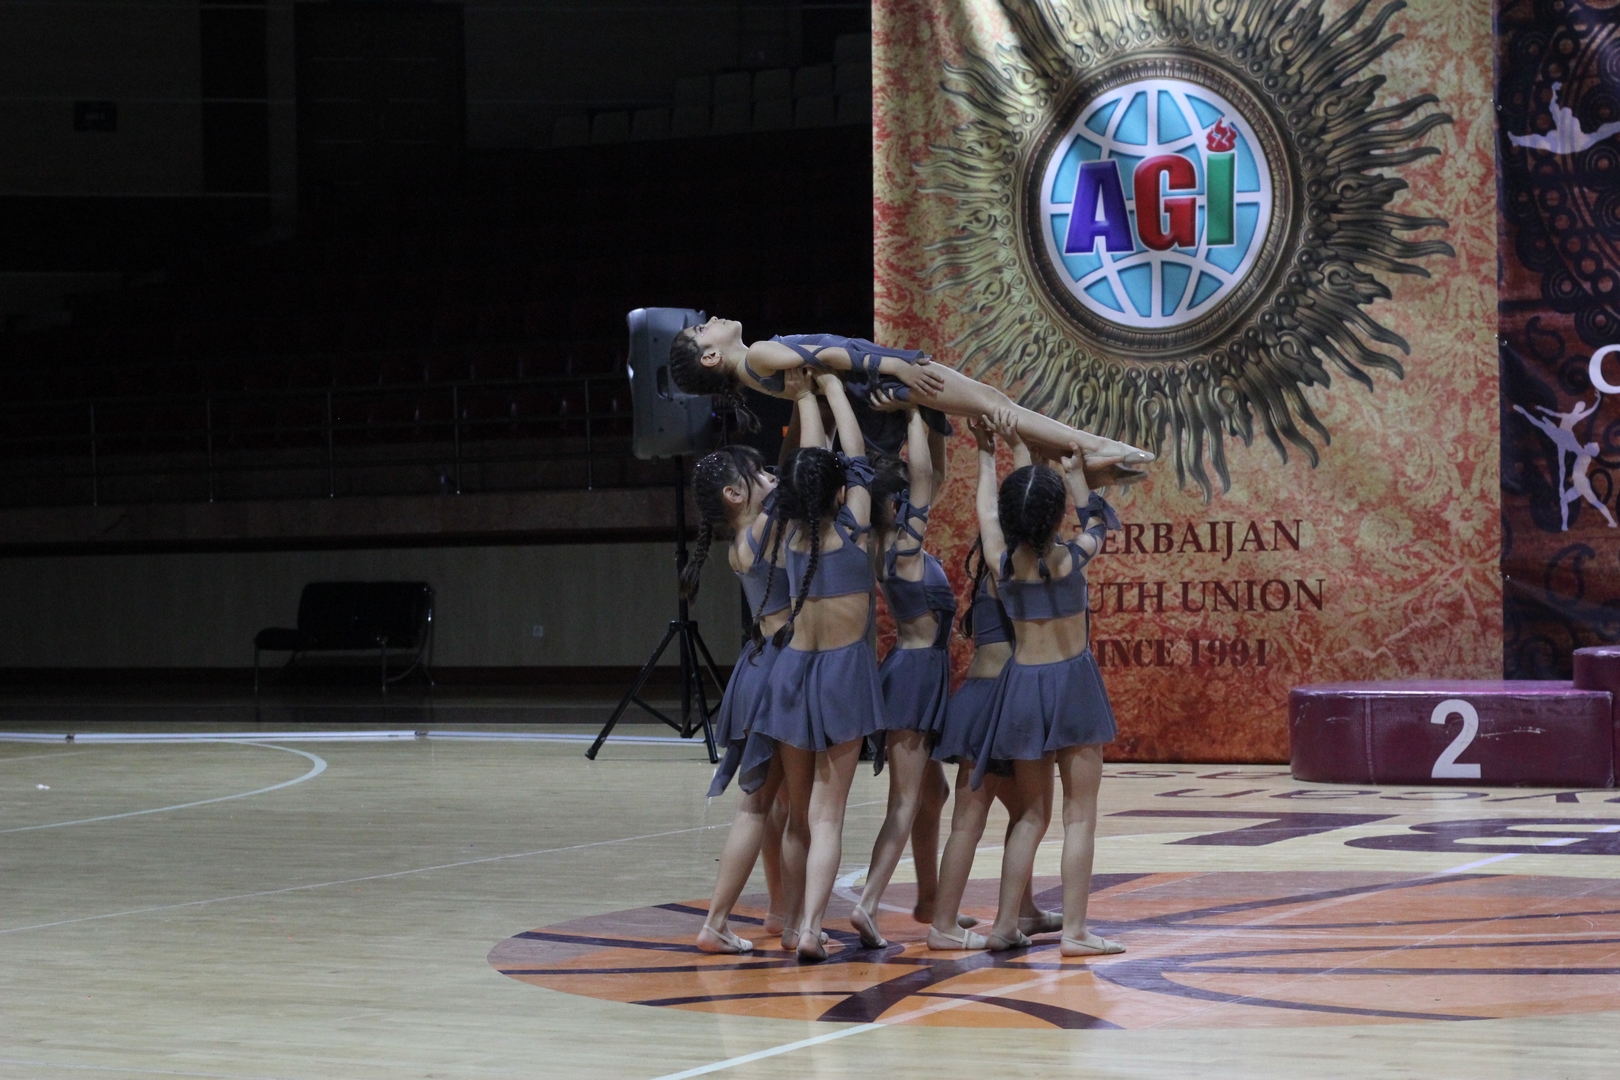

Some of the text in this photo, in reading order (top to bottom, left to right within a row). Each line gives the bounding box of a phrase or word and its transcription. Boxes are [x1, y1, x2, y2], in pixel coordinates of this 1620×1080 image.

[1073, 519, 1303, 562] ERBAIJAN
[1088, 578, 1326, 613] UTH UNION
[1092, 638, 1267, 668] INCE 1991
[1430, 699, 1482, 779] 2
